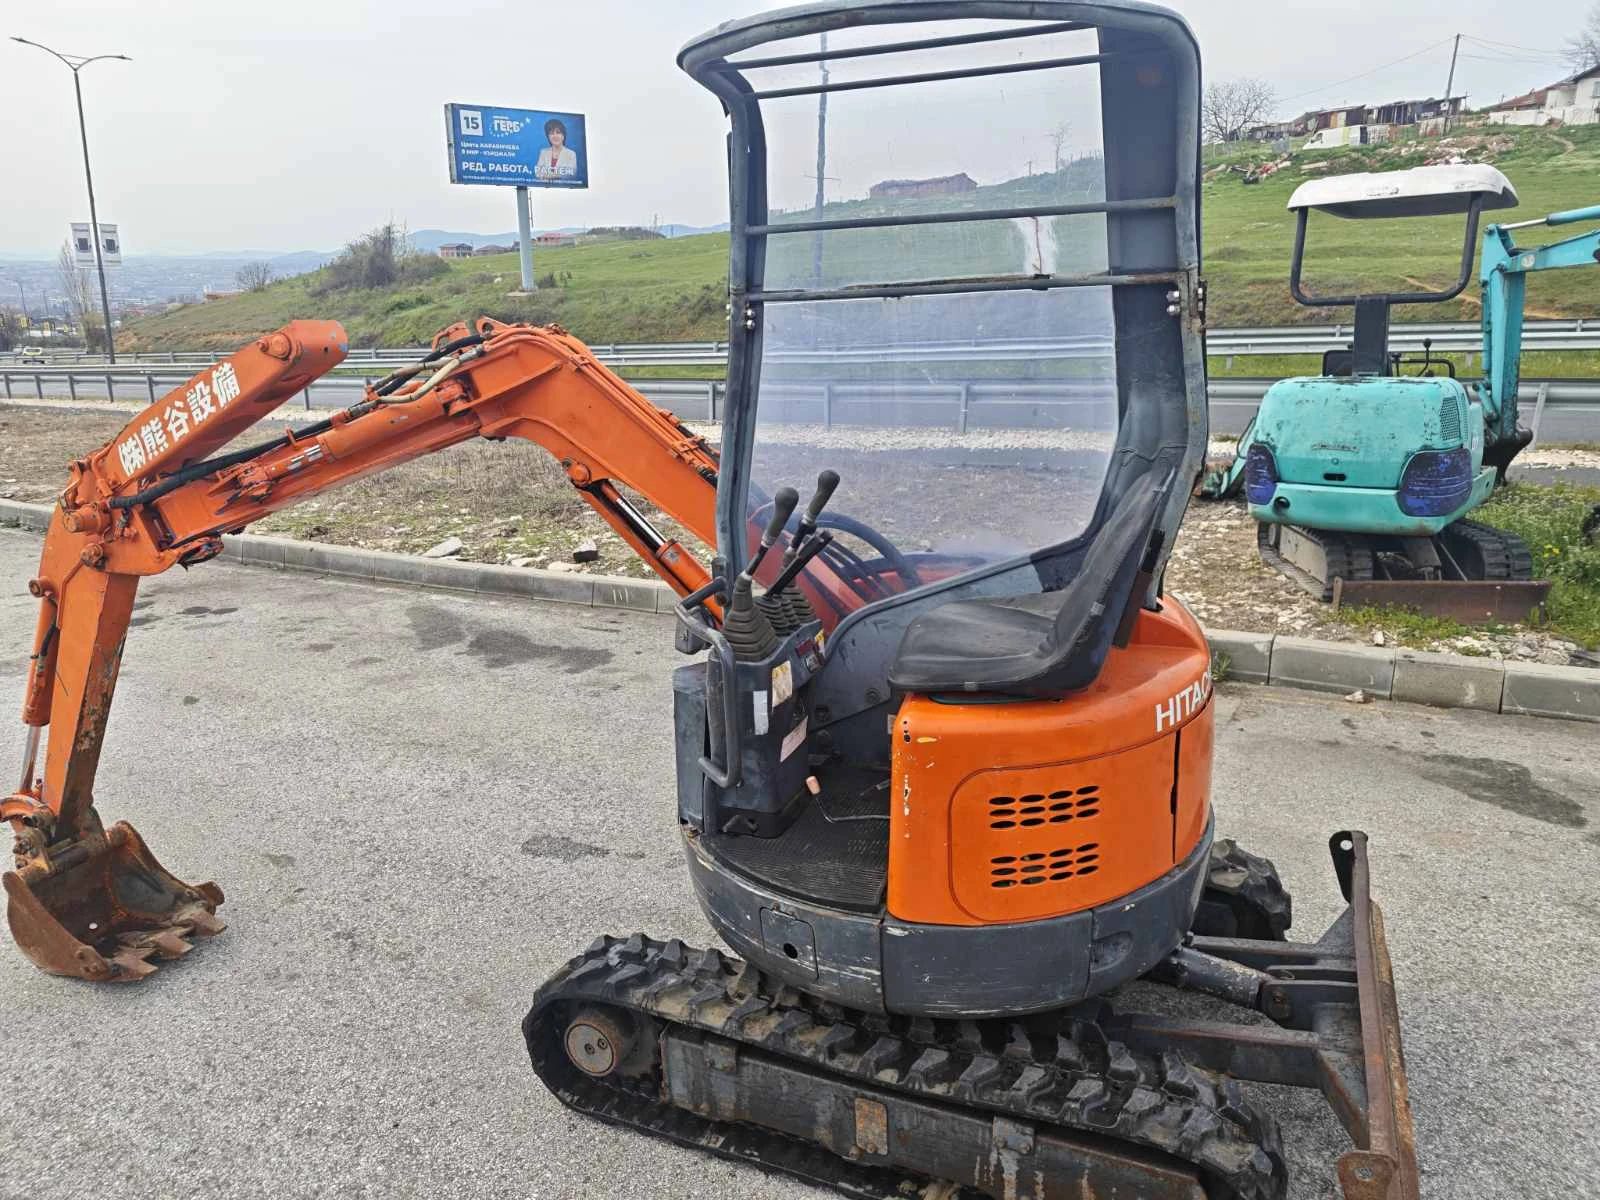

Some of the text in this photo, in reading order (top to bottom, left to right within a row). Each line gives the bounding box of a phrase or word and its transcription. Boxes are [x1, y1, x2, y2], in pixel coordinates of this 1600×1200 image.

[464, 116, 479, 130] 15
[494, 120, 520, 132] ГЕРБ
[462, 162, 486, 173] РЕД,
[489, 163, 532, 175] РАБОТА,
